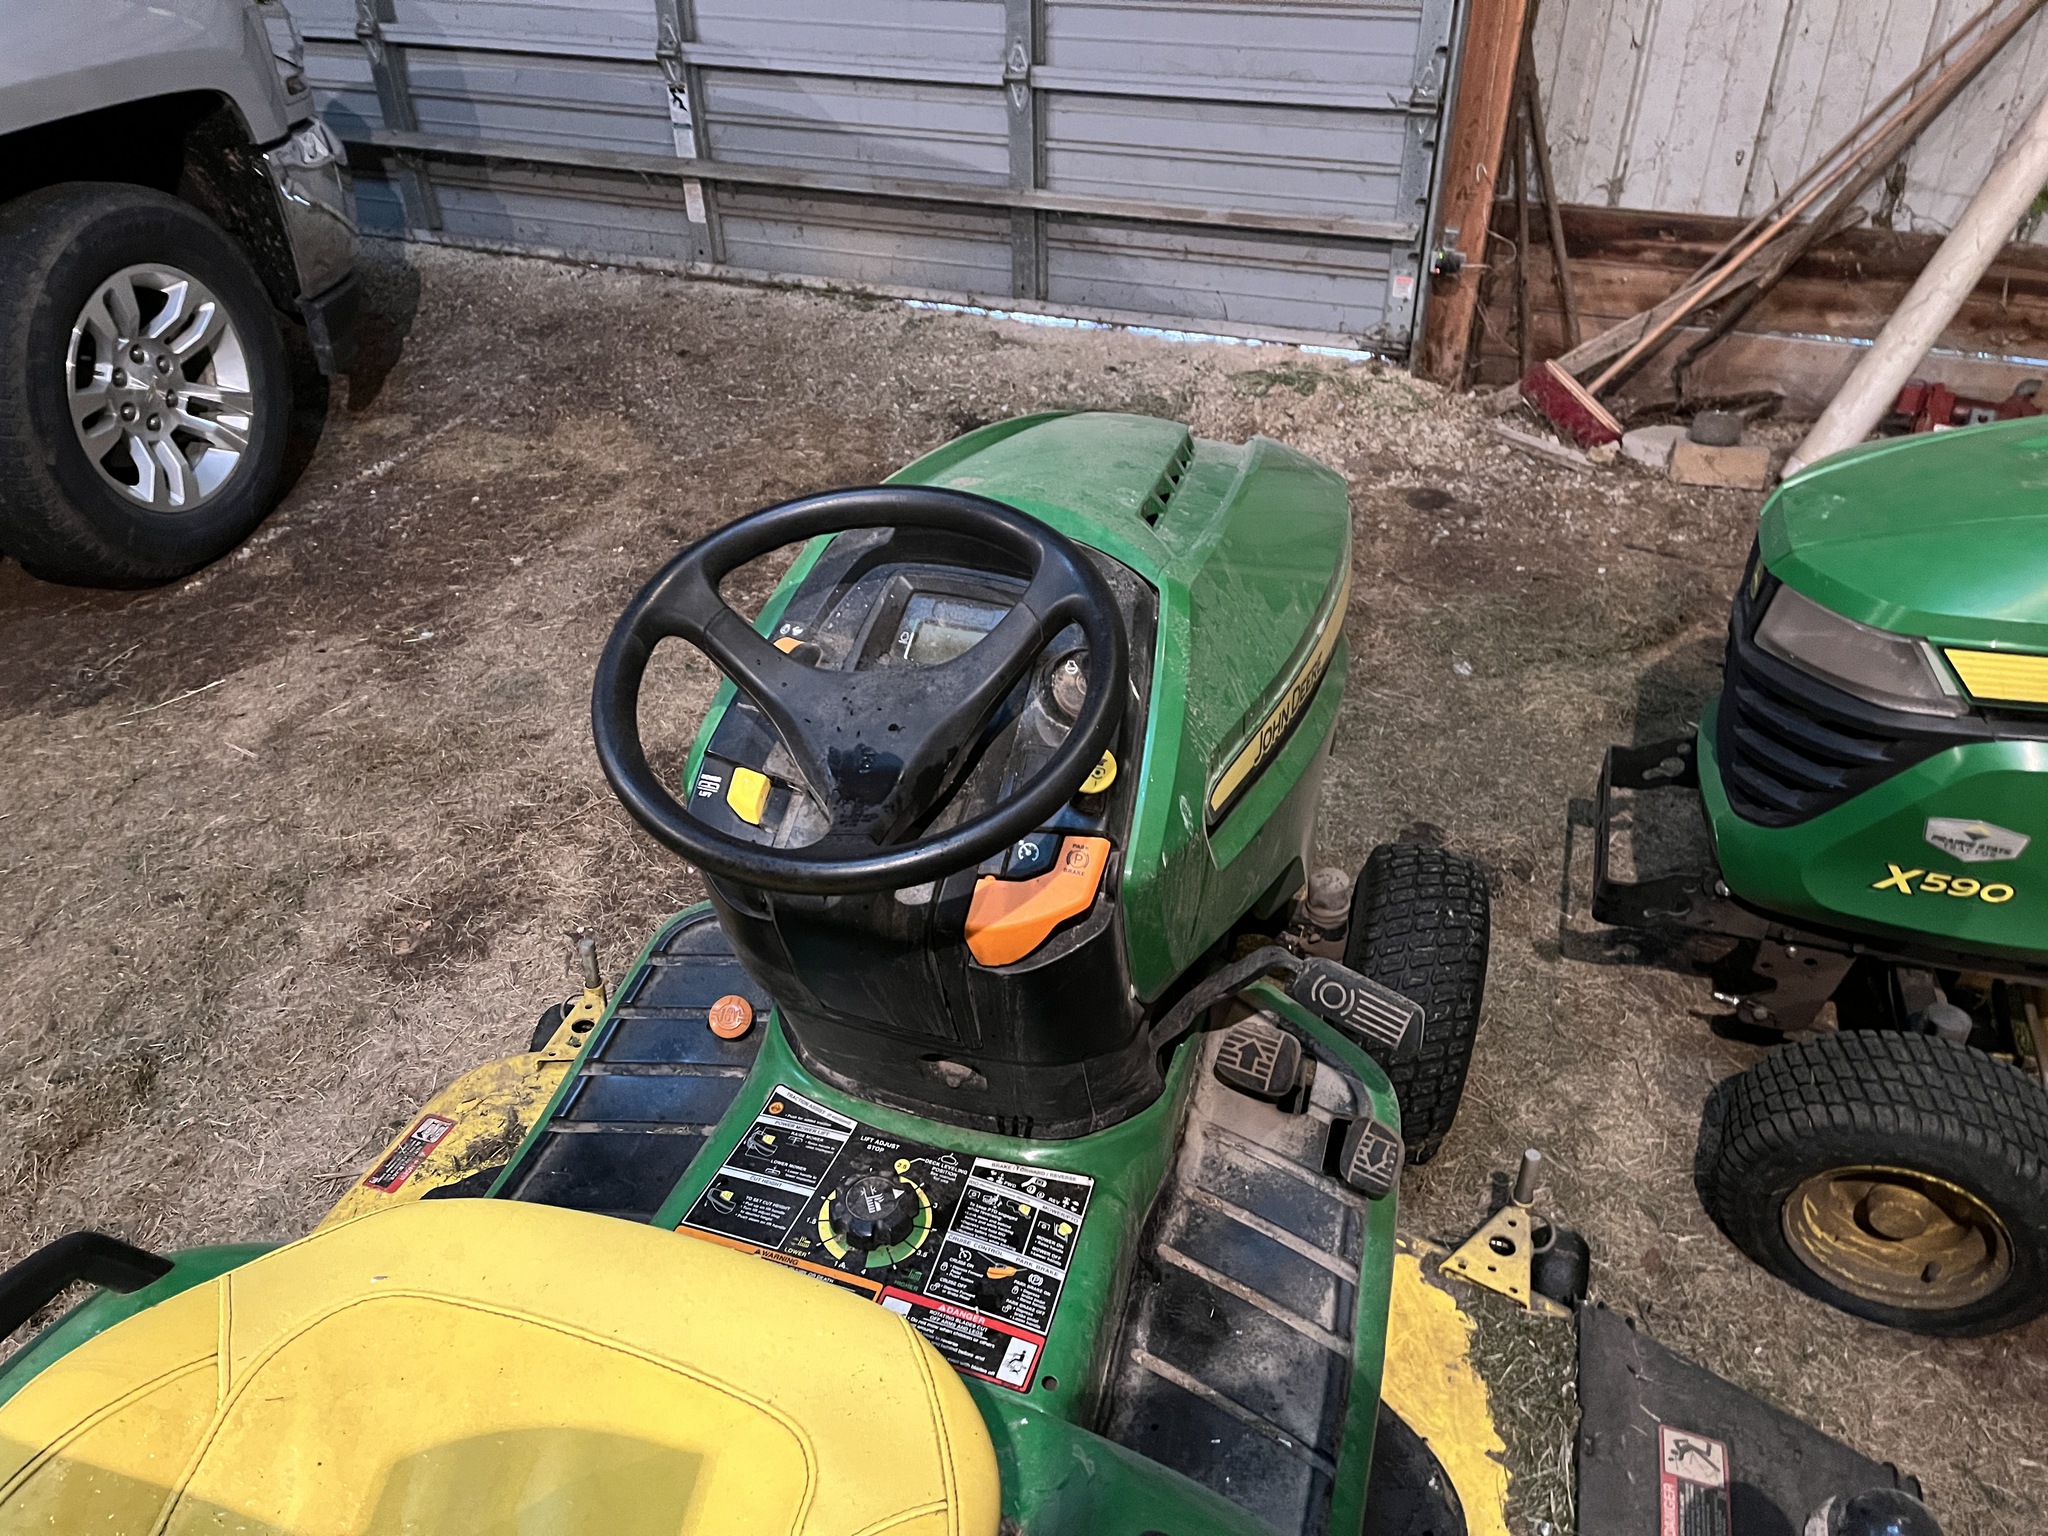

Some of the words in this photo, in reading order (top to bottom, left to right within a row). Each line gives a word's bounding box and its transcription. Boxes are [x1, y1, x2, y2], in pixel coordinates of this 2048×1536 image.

[1254, 703, 1291, 765] JOHN
[1291, 659, 1322, 715] DEERE
[1872, 863, 2014, 903] X590
[775, 1120, 796, 1129] POWER
[796, 1125, 817, 1134] MOWER
[860, 1135, 874, 1143] LIFT
[875, 1139, 900, 1150] ADJUST
[867, 1144, 884, 1153] STOP
[925, 1158, 940, 1166] DECK
[940, 1162, 968, 1175] LEVELING
[932, 1166, 957, 1177] POSITION
[762, 1179, 782, 1187] HEIGHT
[1048, 1197, 1060, 1205] REV
[948, 1235, 971, 1247] CRUISE
[973, 1242, 1004, 1256] CONTROL
[1036, 1235, 1056, 1245] MOWER
[784, 1247, 808, 1257] LOWER
[1031, 1246, 1051, 1256] MOWER
[761, 1250, 799, 1265] WARNING
[1015, 1258, 1034, 1267] PARK
[1036, 1264, 1059, 1277] BRAKE
[816, 1275, 834, 1283] DEATH
[894, 1280, 918, 1290] HIGHER
[1027, 1285, 1042, 1293] BRAKE
[1019, 1303, 1035, 1312] BRAKE
[929, 1310, 955, 1321] ROTATING
[955, 1318, 976, 1328] BLADES
[946, 1306, 986, 1324] DANGER
[941, 1319, 956, 1327] ARMS
[969, 1329, 983, 1337] LEGS
